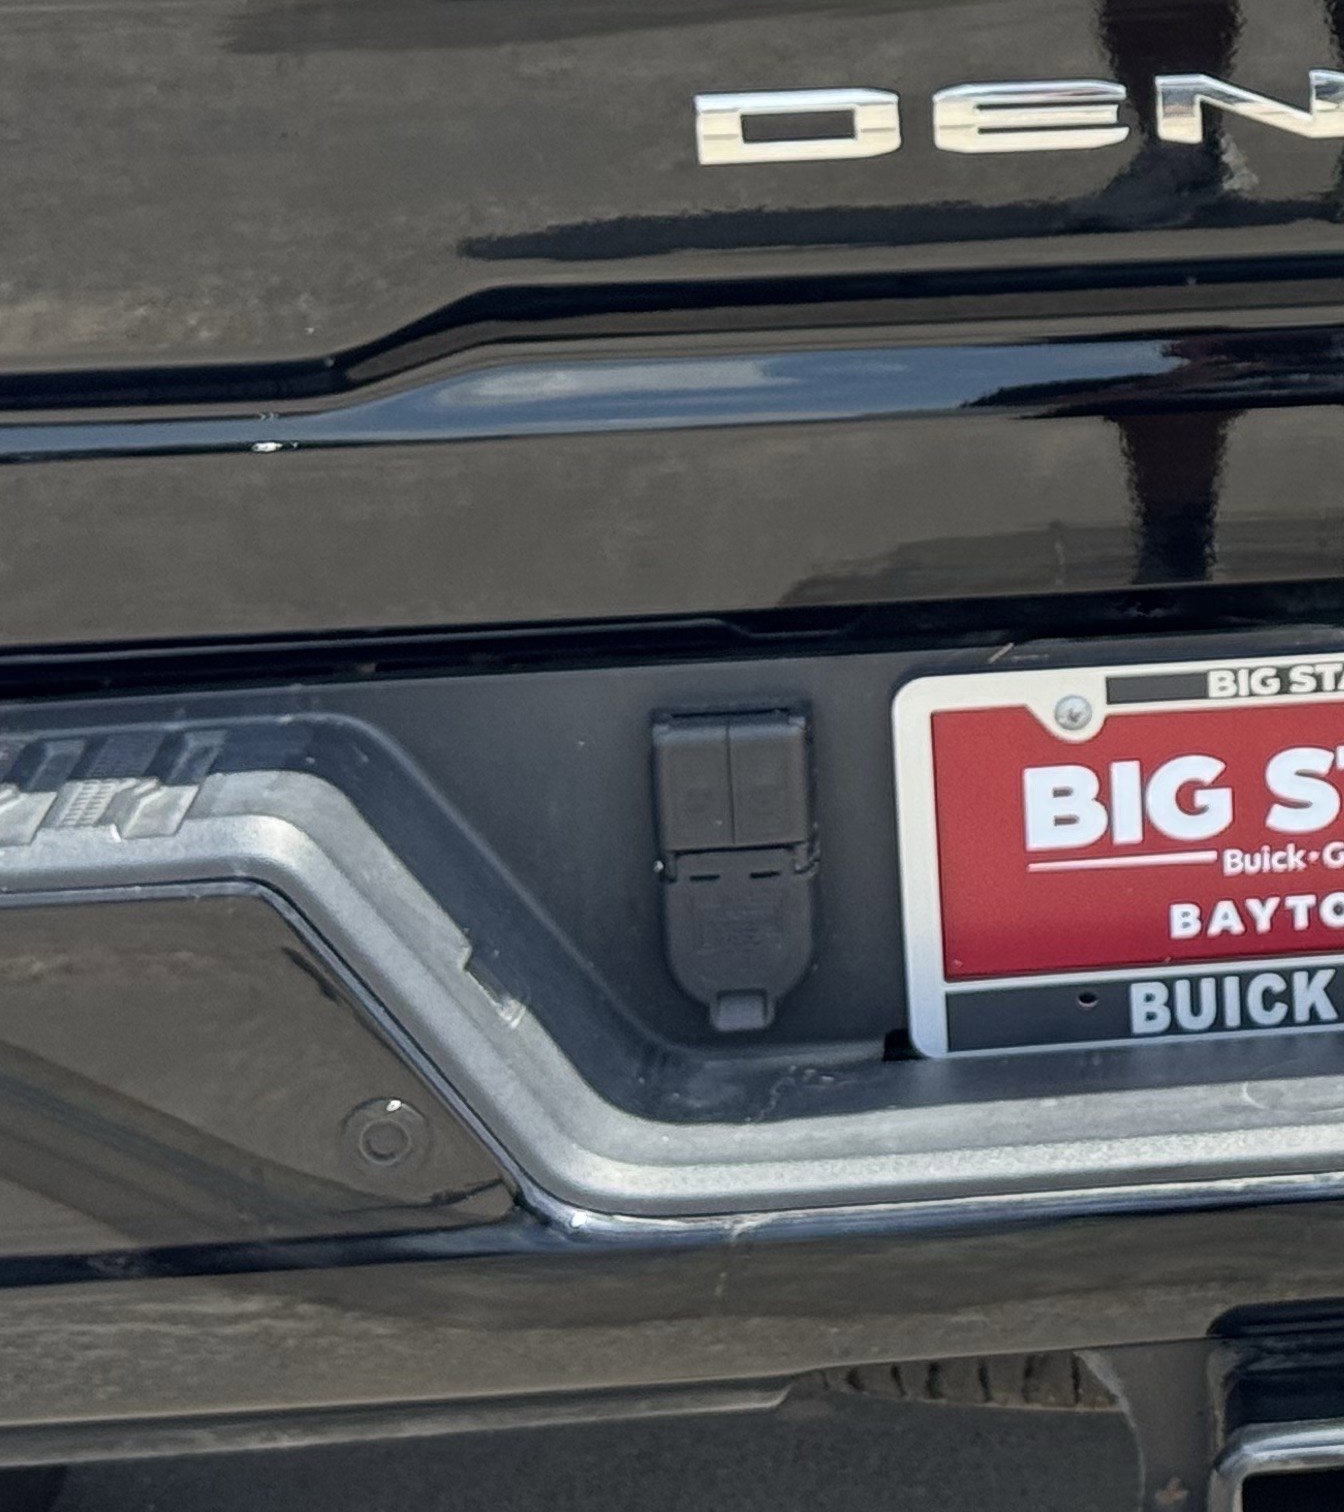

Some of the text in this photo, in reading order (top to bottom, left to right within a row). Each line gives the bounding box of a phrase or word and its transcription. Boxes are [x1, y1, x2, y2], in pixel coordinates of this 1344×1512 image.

[1207, 666, 1281, 699] BIG
[1022, 754, 1234, 853] BIG
[1129, 968, 1338, 1035] BUICK
